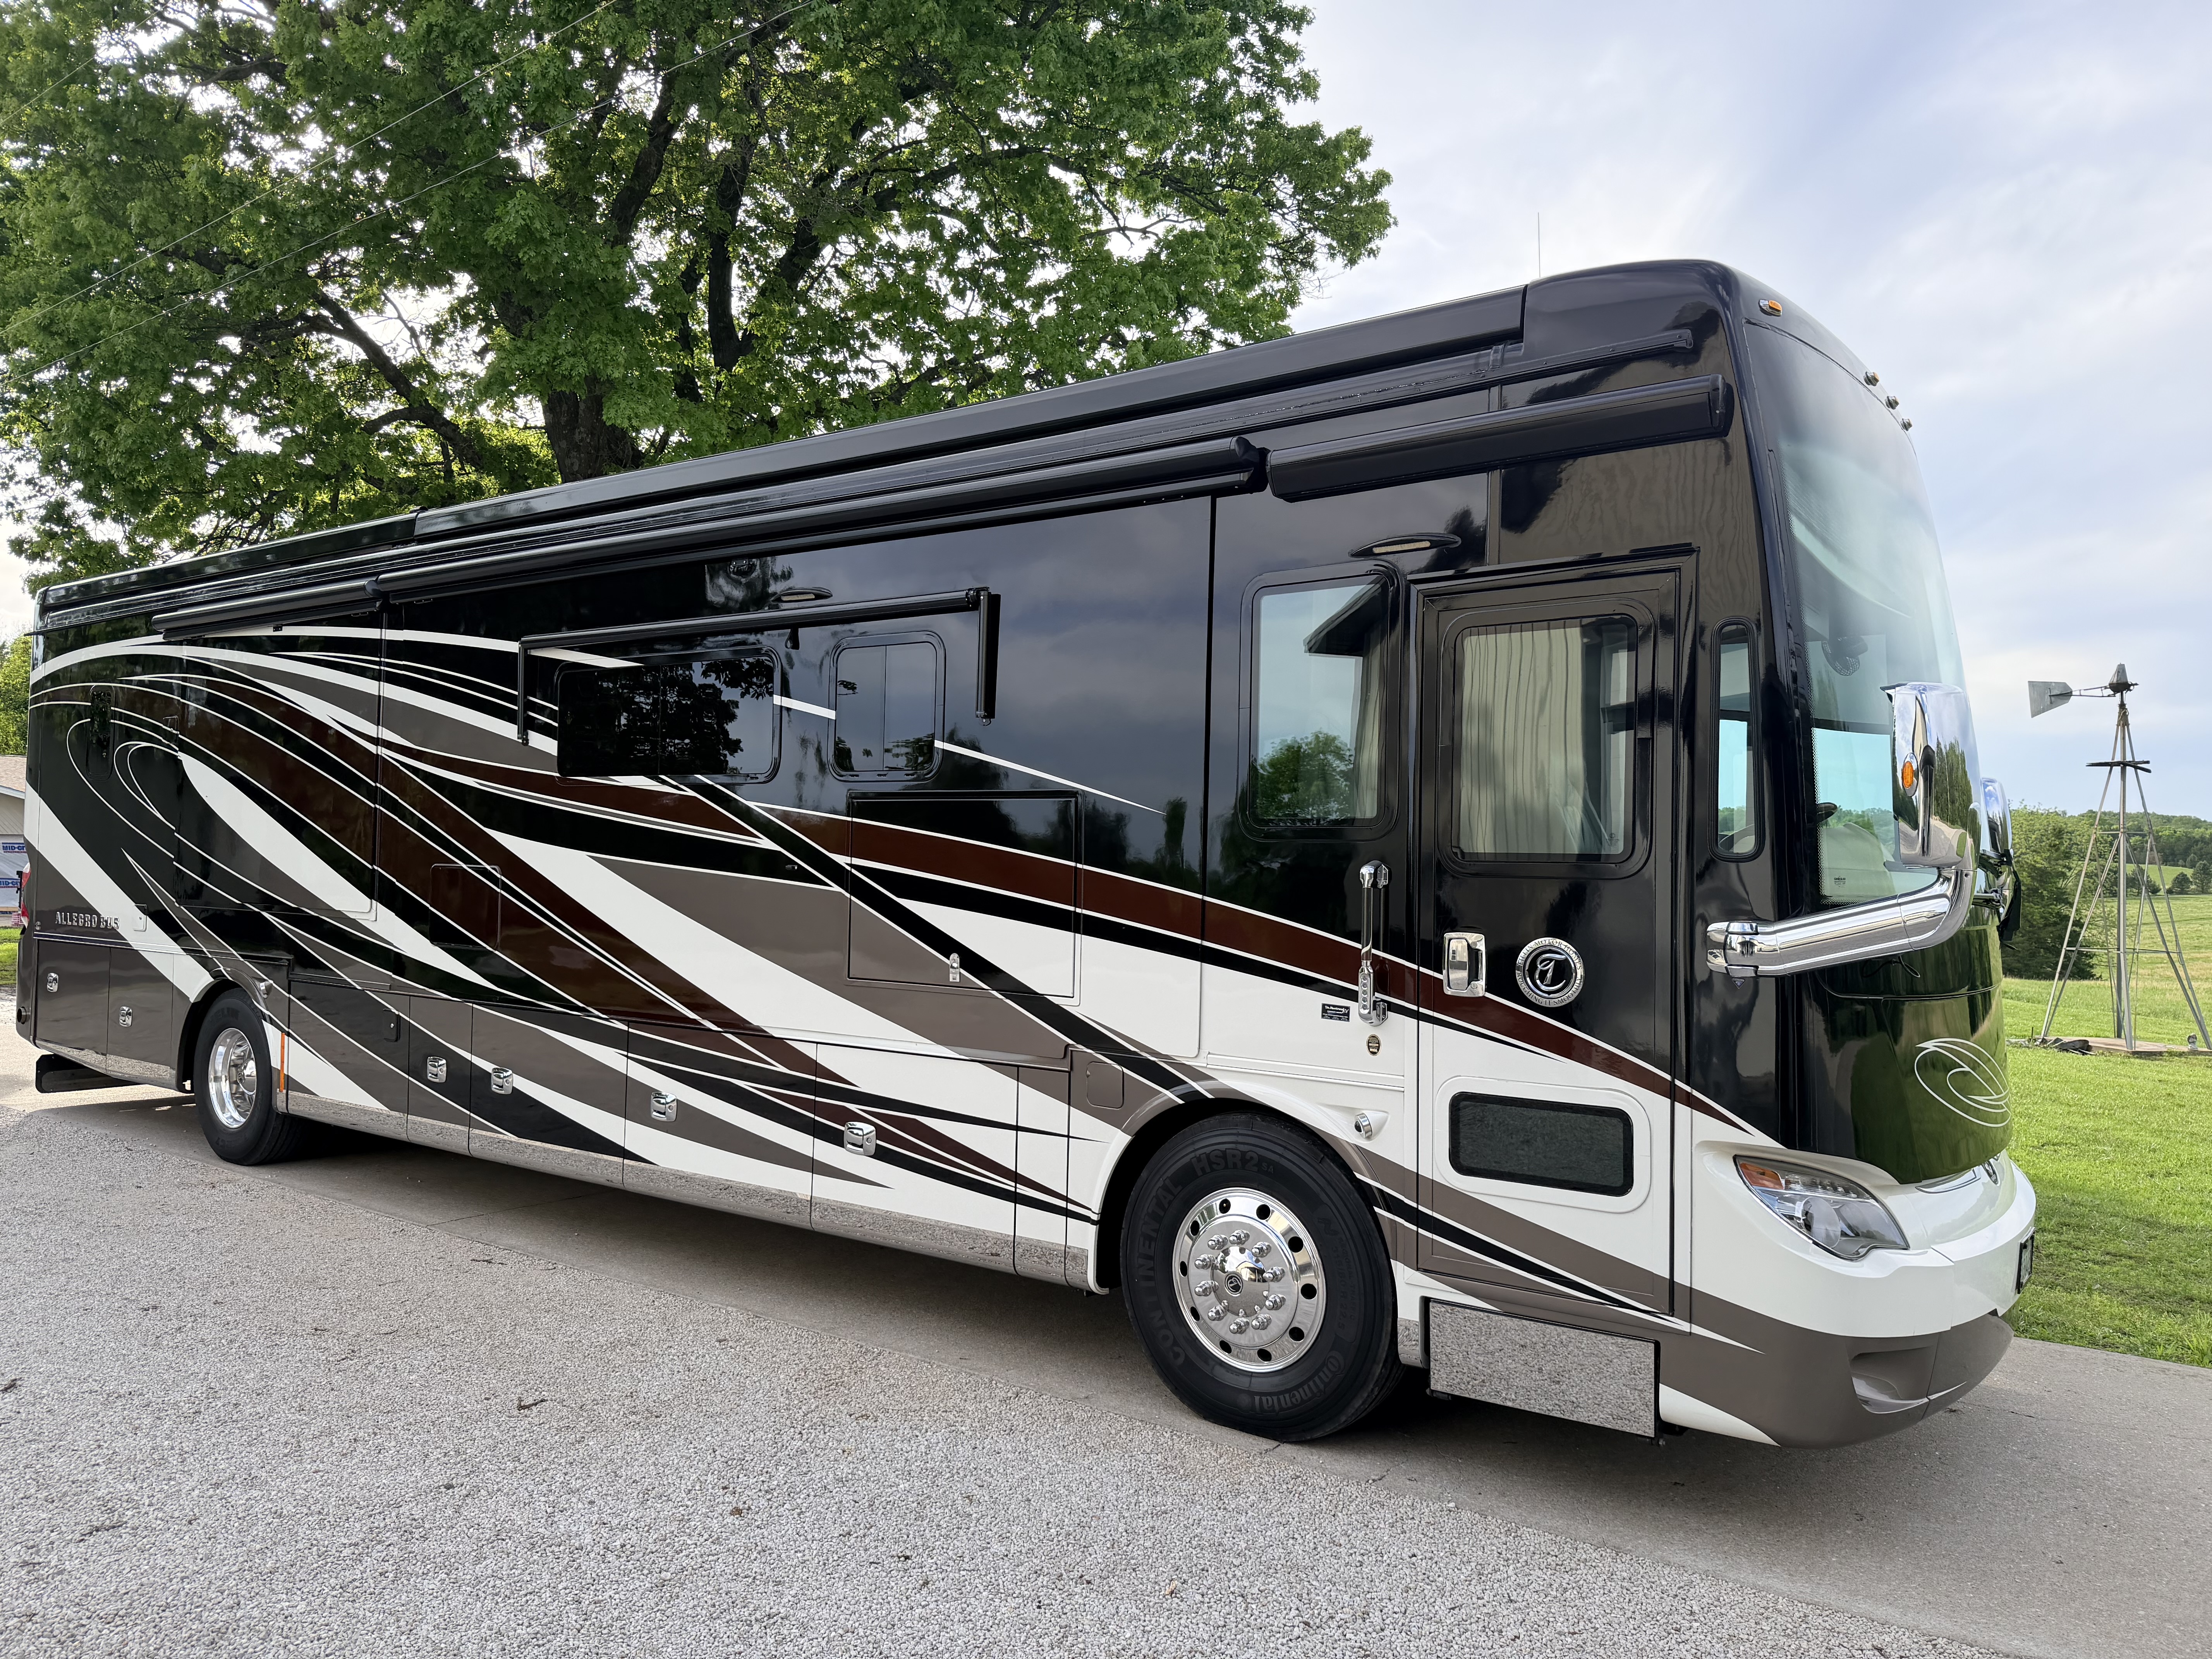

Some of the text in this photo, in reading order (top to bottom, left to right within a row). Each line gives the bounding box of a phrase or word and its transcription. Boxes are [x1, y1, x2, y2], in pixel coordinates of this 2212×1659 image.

[55, 912, 120, 929] ALLEGRO BUS
[1534, 939, 1563, 947] MOTOR
[1564, 945, 1583, 970] HOMES
[1517, 973, 1542, 1004] ROUGHING
[1554, 977, 1583, 1005] SMOOTHLY
[1190, 1148, 1274, 1177] HSR2 SA
[1138, 1176, 1185, 1366] CONTINENTAL
[1338, 1303, 1348, 1330] 22.5
[1253, 1350, 1345, 1416] Continental
